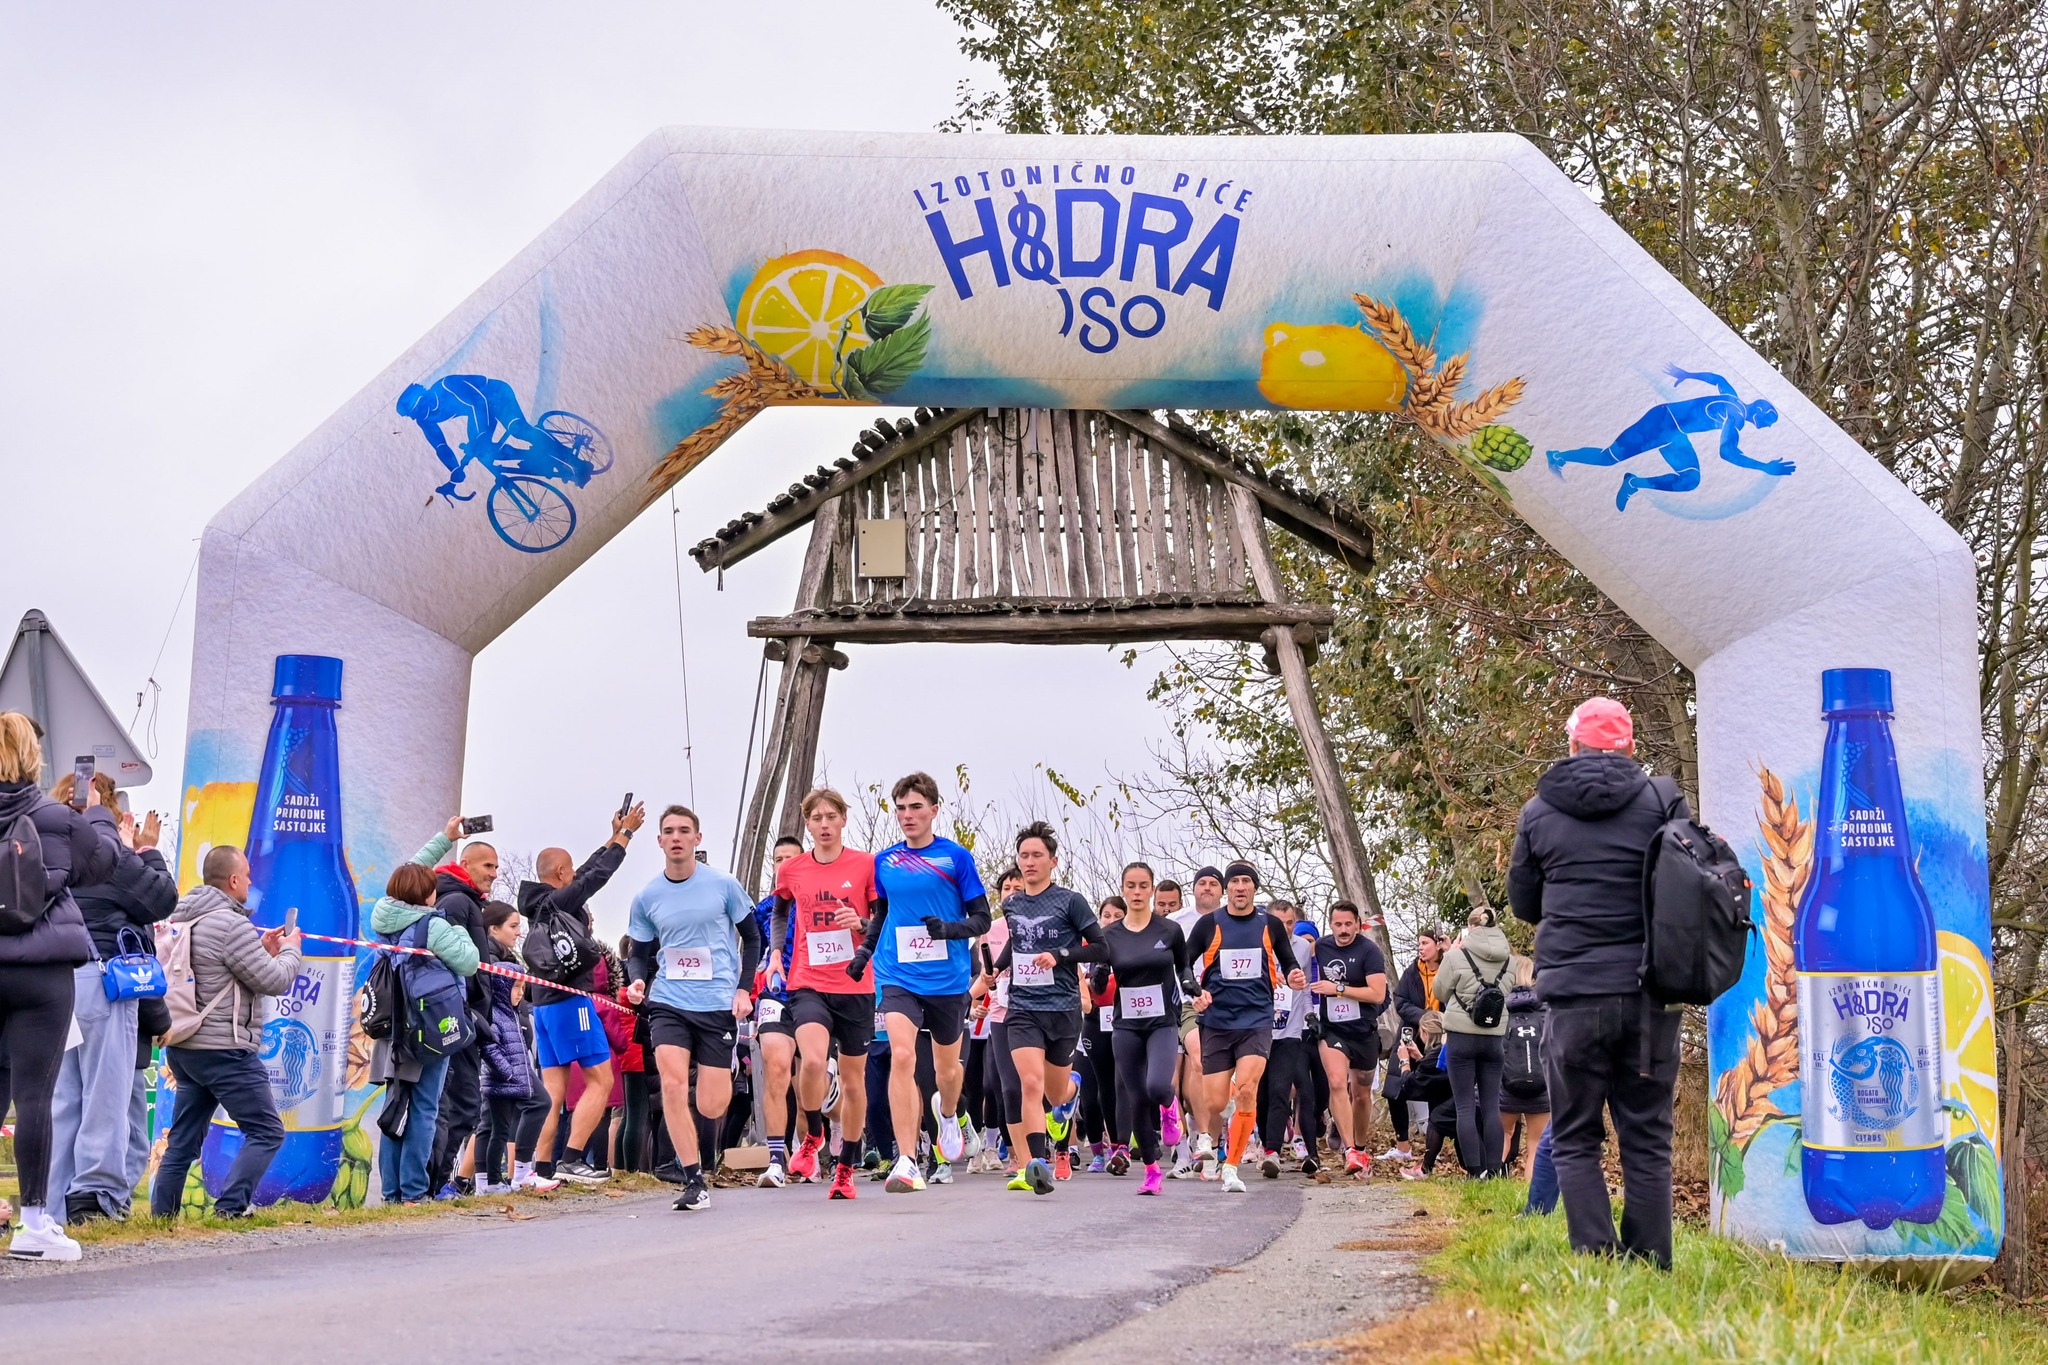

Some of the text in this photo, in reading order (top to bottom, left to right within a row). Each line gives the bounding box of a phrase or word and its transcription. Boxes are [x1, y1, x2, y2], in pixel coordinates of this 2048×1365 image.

[913, 161, 1253, 213] IZOTONIČNO PIĆE
[284, 793, 319, 807] SADRŽI
[275, 807, 326, 820] PRIRODNE
[1850, 807, 1885, 821] SADRŽI
[273, 820, 326, 833] SASTOJKE
[1842, 822, 1893, 834] PRIRODNE
[1840, 836, 1896, 847] SASTOJKE
[1048, 929, 1059, 939] HS
[816, 942, 844, 953] 521A
[909, 937, 934, 949] 422
[677, 957, 701, 968] 423
[1231, 958, 1252, 969] 377
[306, 967, 325, 981] PIĆE
[1017, 964, 1045, 975] 522A
[133, 984, 155, 992] adidas
[1828, 979, 1912, 997] IZOTONIČNO PIĆE
[1130, 996, 1153, 1008] 383
[1335, 1004, 1350, 1013] 421
[322, 1044, 329, 1052] 15
[1917, 1060, 1923, 1068] 15
[1857, 1089, 1879, 1097] BOGATO
[1855, 1134, 1882, 1142] CITRUS
